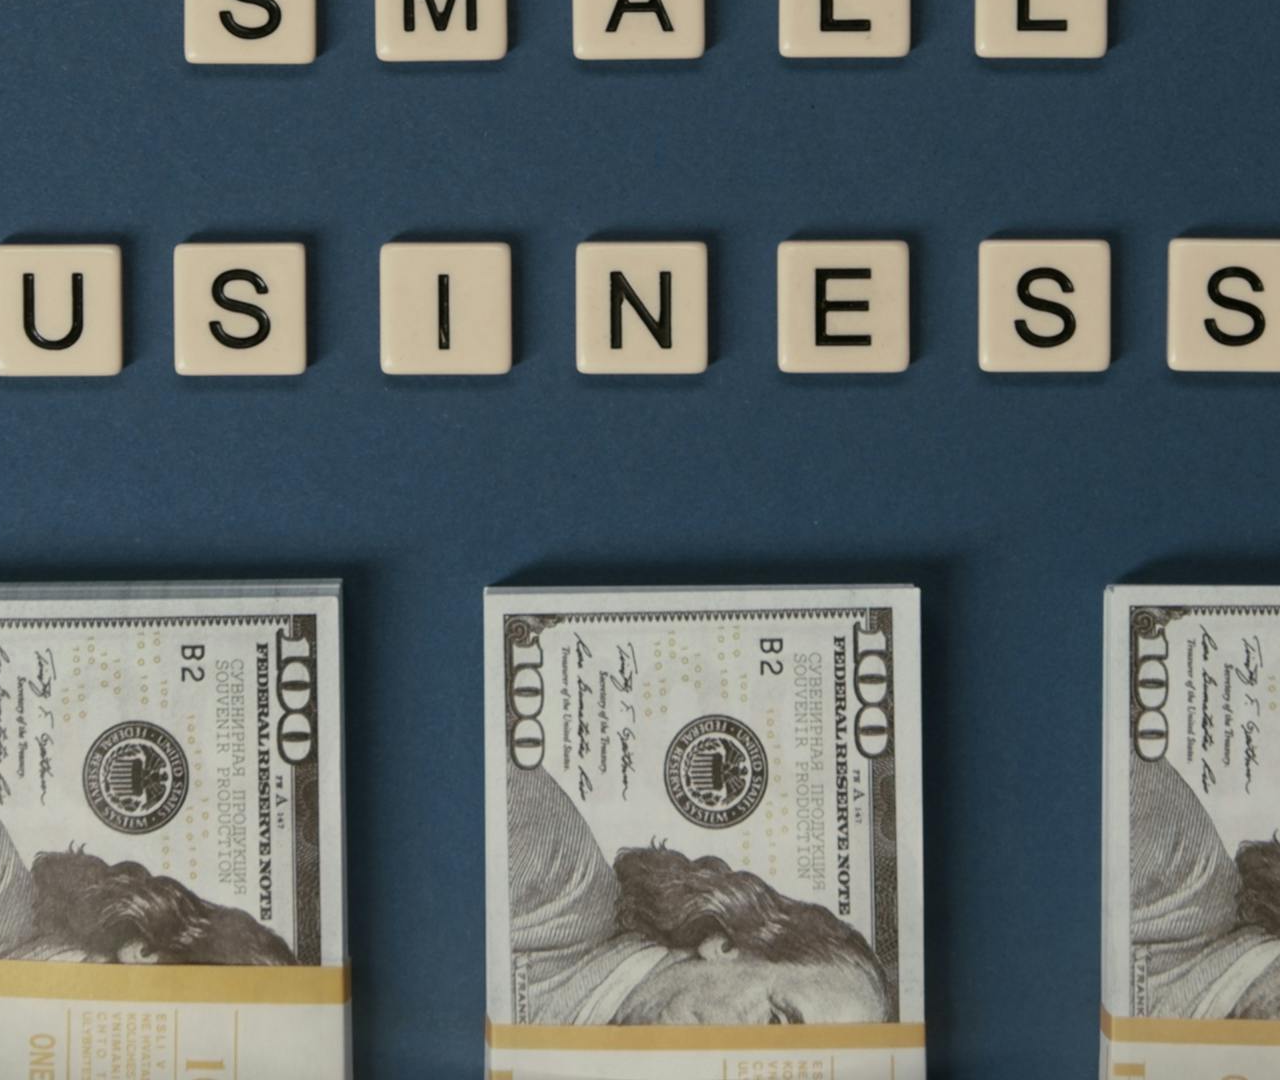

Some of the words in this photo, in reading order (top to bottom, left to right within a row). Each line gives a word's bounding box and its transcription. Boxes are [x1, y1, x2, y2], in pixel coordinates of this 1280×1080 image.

[256, 642, 270, 747] FEDERAL
[276, 627, 313, 767] 100
[509, 635, 545, 771] 100
[793, 653, 808, 748] SOUVENIR
[808, 652, 823, 771] СУВЕНИРНАЯ
[833, 635, 847, 740] FEDERAL
[853, 621, 889, 760] 100
[1133, 627, 1170, 763] 100
[257, 750, 271, 856] RESERVE
[794, 761, 810, 879] PRODUCTION
[809, 784, 826, 891] ПРОДУКЦИЯ
[835, 743, 849, 850] RESERVE
[259, 859, 273, 920] NOTE
[837, 853, 851, 915] NOTE
